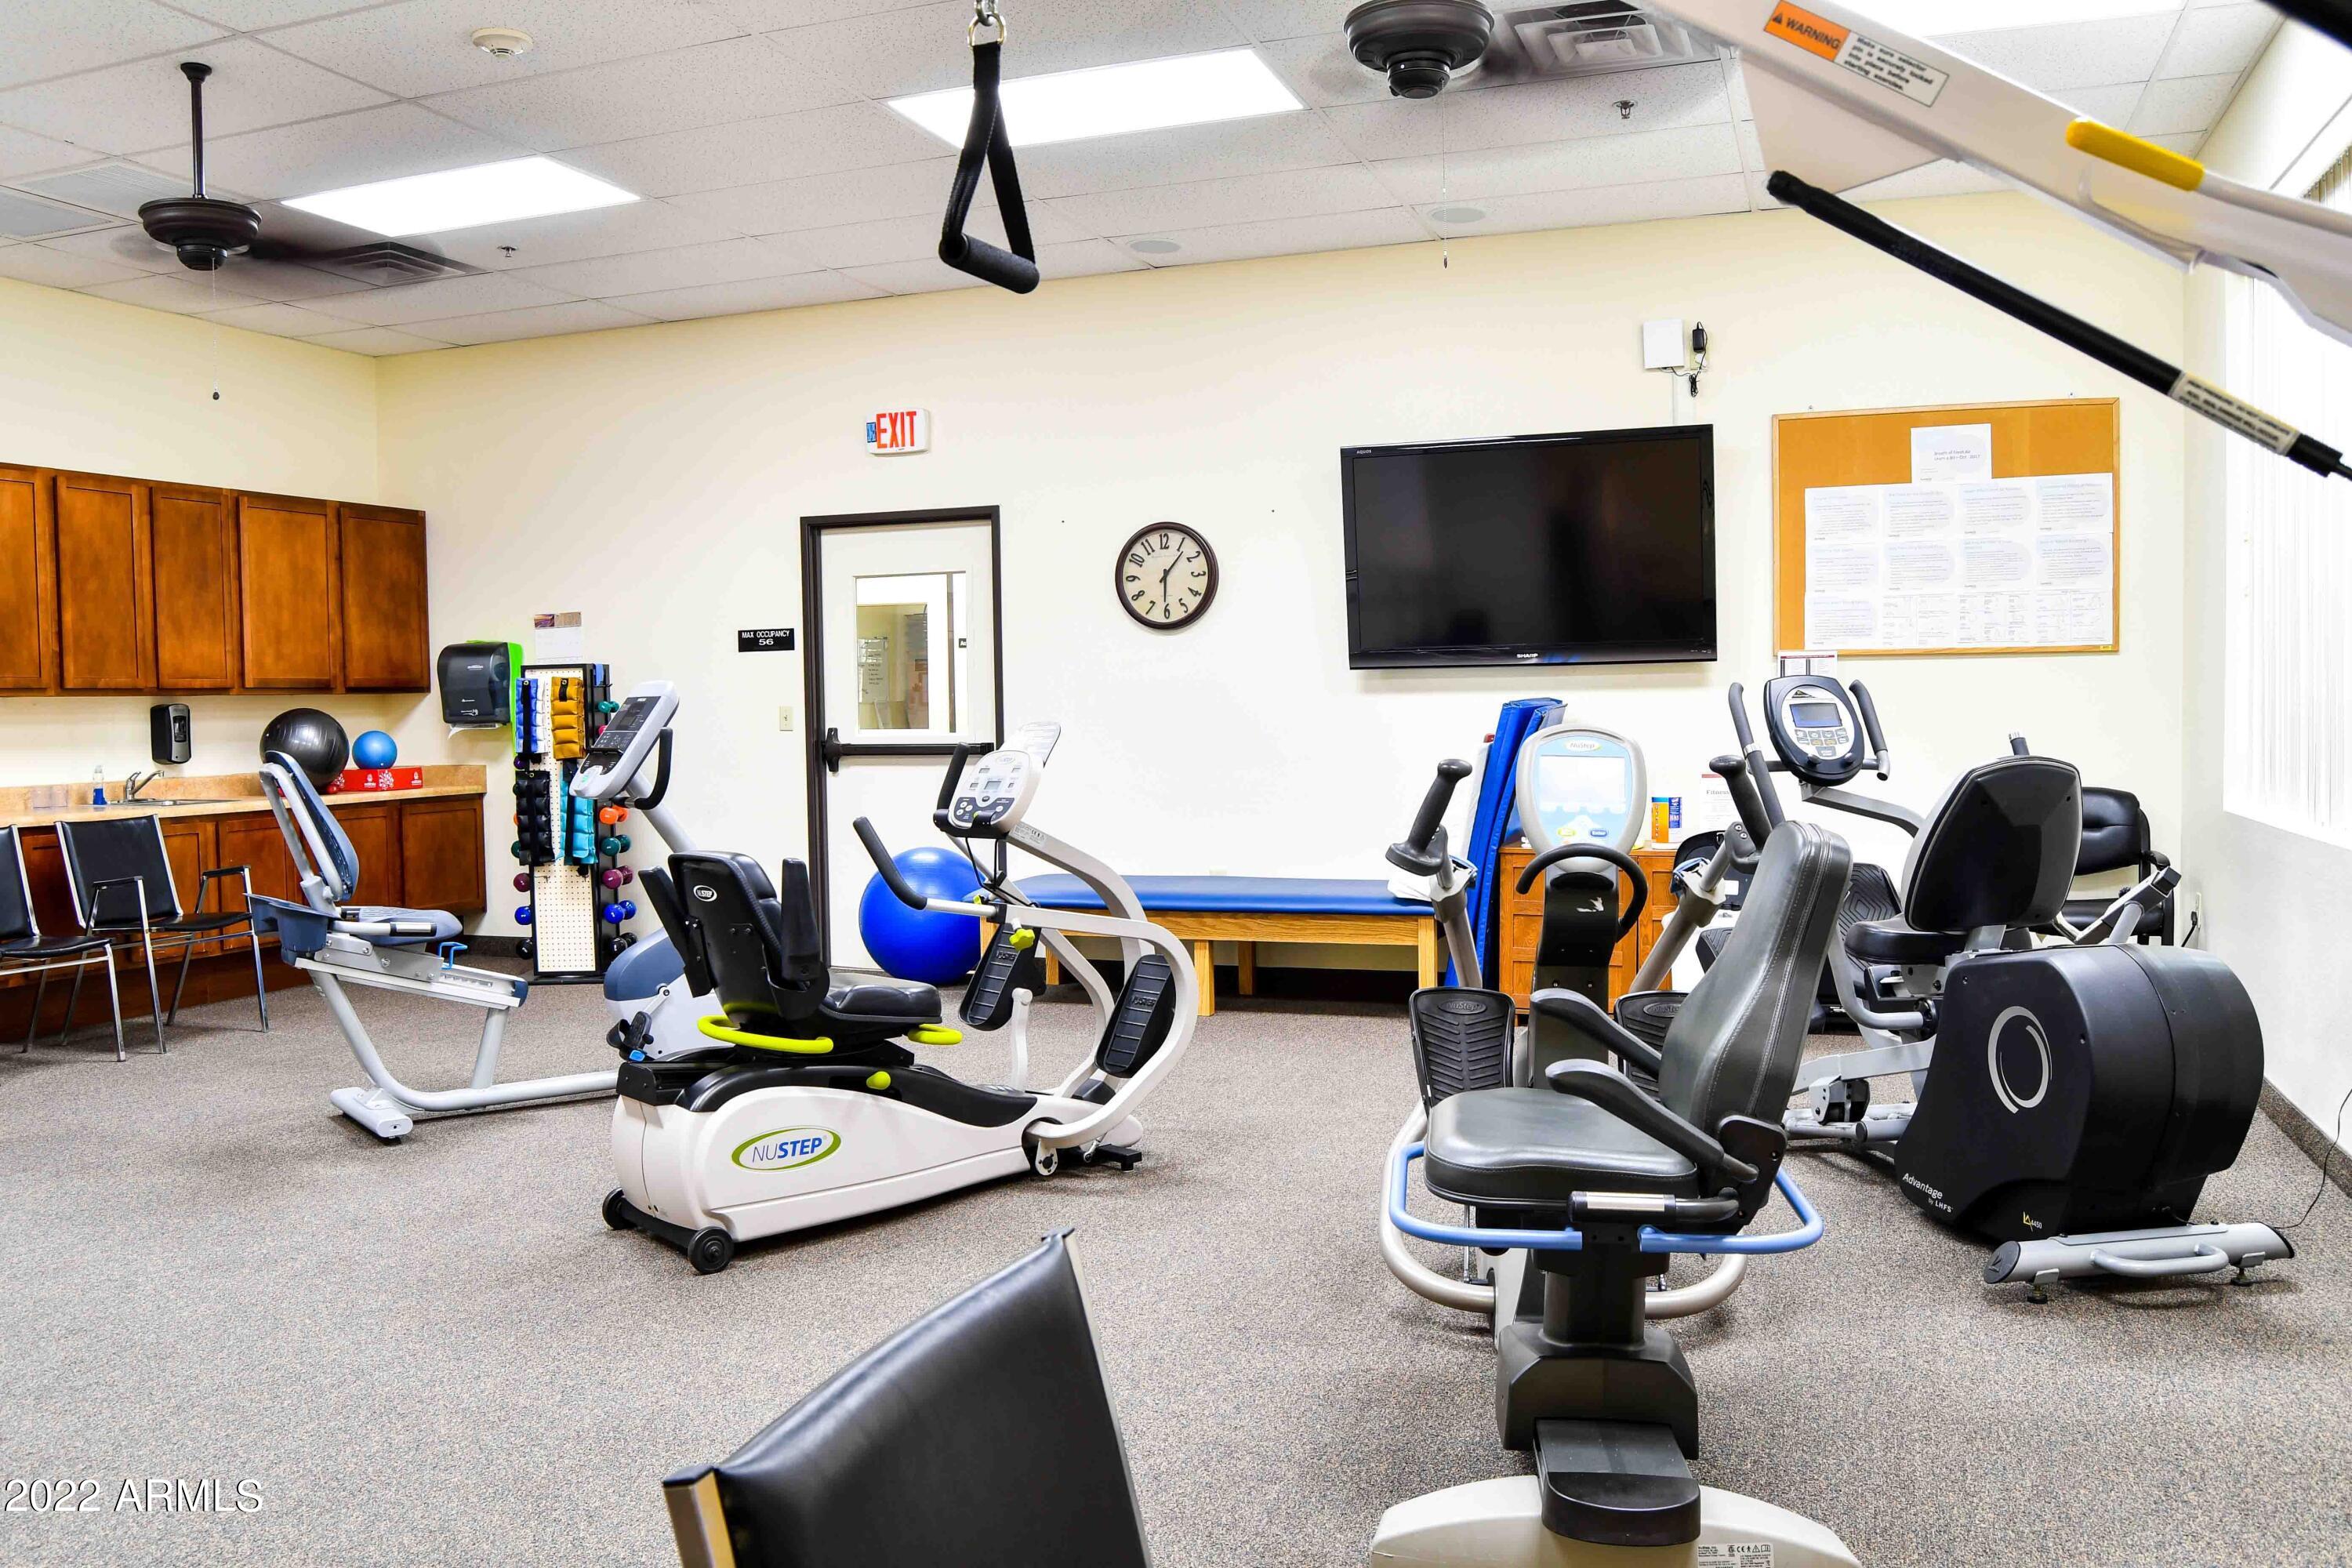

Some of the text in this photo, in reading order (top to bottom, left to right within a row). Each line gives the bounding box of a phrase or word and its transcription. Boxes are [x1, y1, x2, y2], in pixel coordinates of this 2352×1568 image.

[1787, 17, 1842, 49] WARNING
[877, 411, 916, 448] EXIT
[1141, 539, 1156, 556] 11
[1160, 533, 1170, 550] 12
[1177, 537, 1185, 552] 1
[1129, 553, 1145, 568] 10
[1186, 551, 1201, 562] 2
[1131, 590, 1145, 601] 8
[1188, 587, 1202, 597] 4
[1145, 601, 1156, 615] 7
[1163, 604, 1171, 619] 6
[1178, 598, 1189, 613] 5
[752, 1137, 822, 1163] NUSTEP
[1902, 1172, 1943, 1200] Advantage
[1935, 1200, 1951, 1213] LHFS
